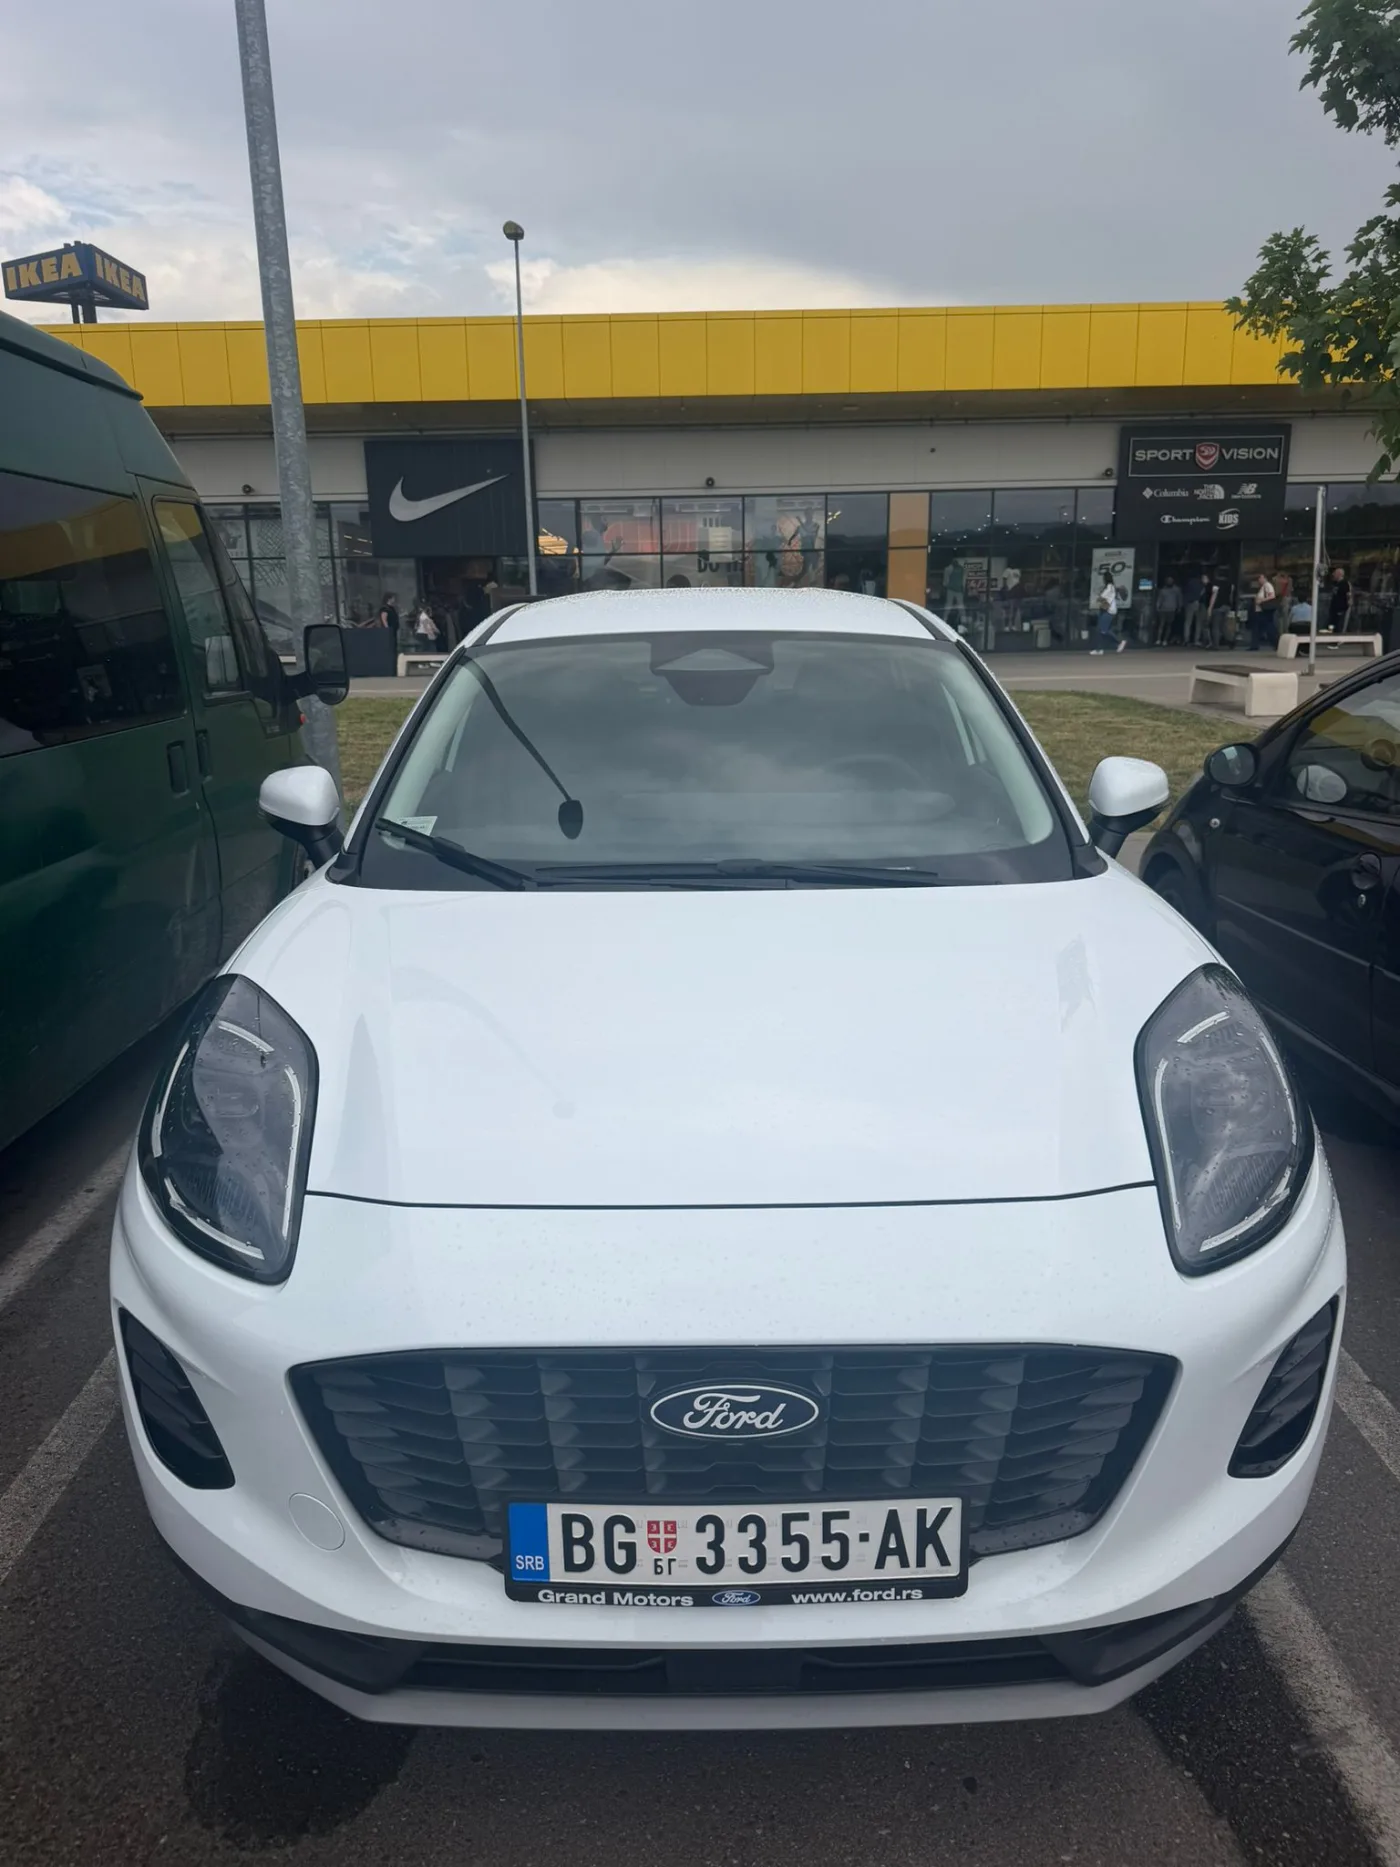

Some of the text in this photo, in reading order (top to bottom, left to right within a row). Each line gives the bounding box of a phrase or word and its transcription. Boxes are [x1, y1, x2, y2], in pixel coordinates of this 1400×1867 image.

[6, 252, 83, 291] IKEA
[95, 252, 146, 302] IKEA
[1135, 447, 1279, 461] SPORT VISION
[1154, 488, 1189, 498] Columbia
[1160, 514, 1211, 525] Champion
[1218, 513, 1239, 524] KIDS
[683, 1392, 786, 1429] Ford
[561, 1513, 637, 1575] BG
[515, 1554, 545, 1571] SRB
[654, 1557, 677, 1576] БГ
[537, 1588, 694, 1607] Grand Motors
[721, 1592, 751, 1604] Ford
[792, 1588, 923, 1604] www.ford.rs
